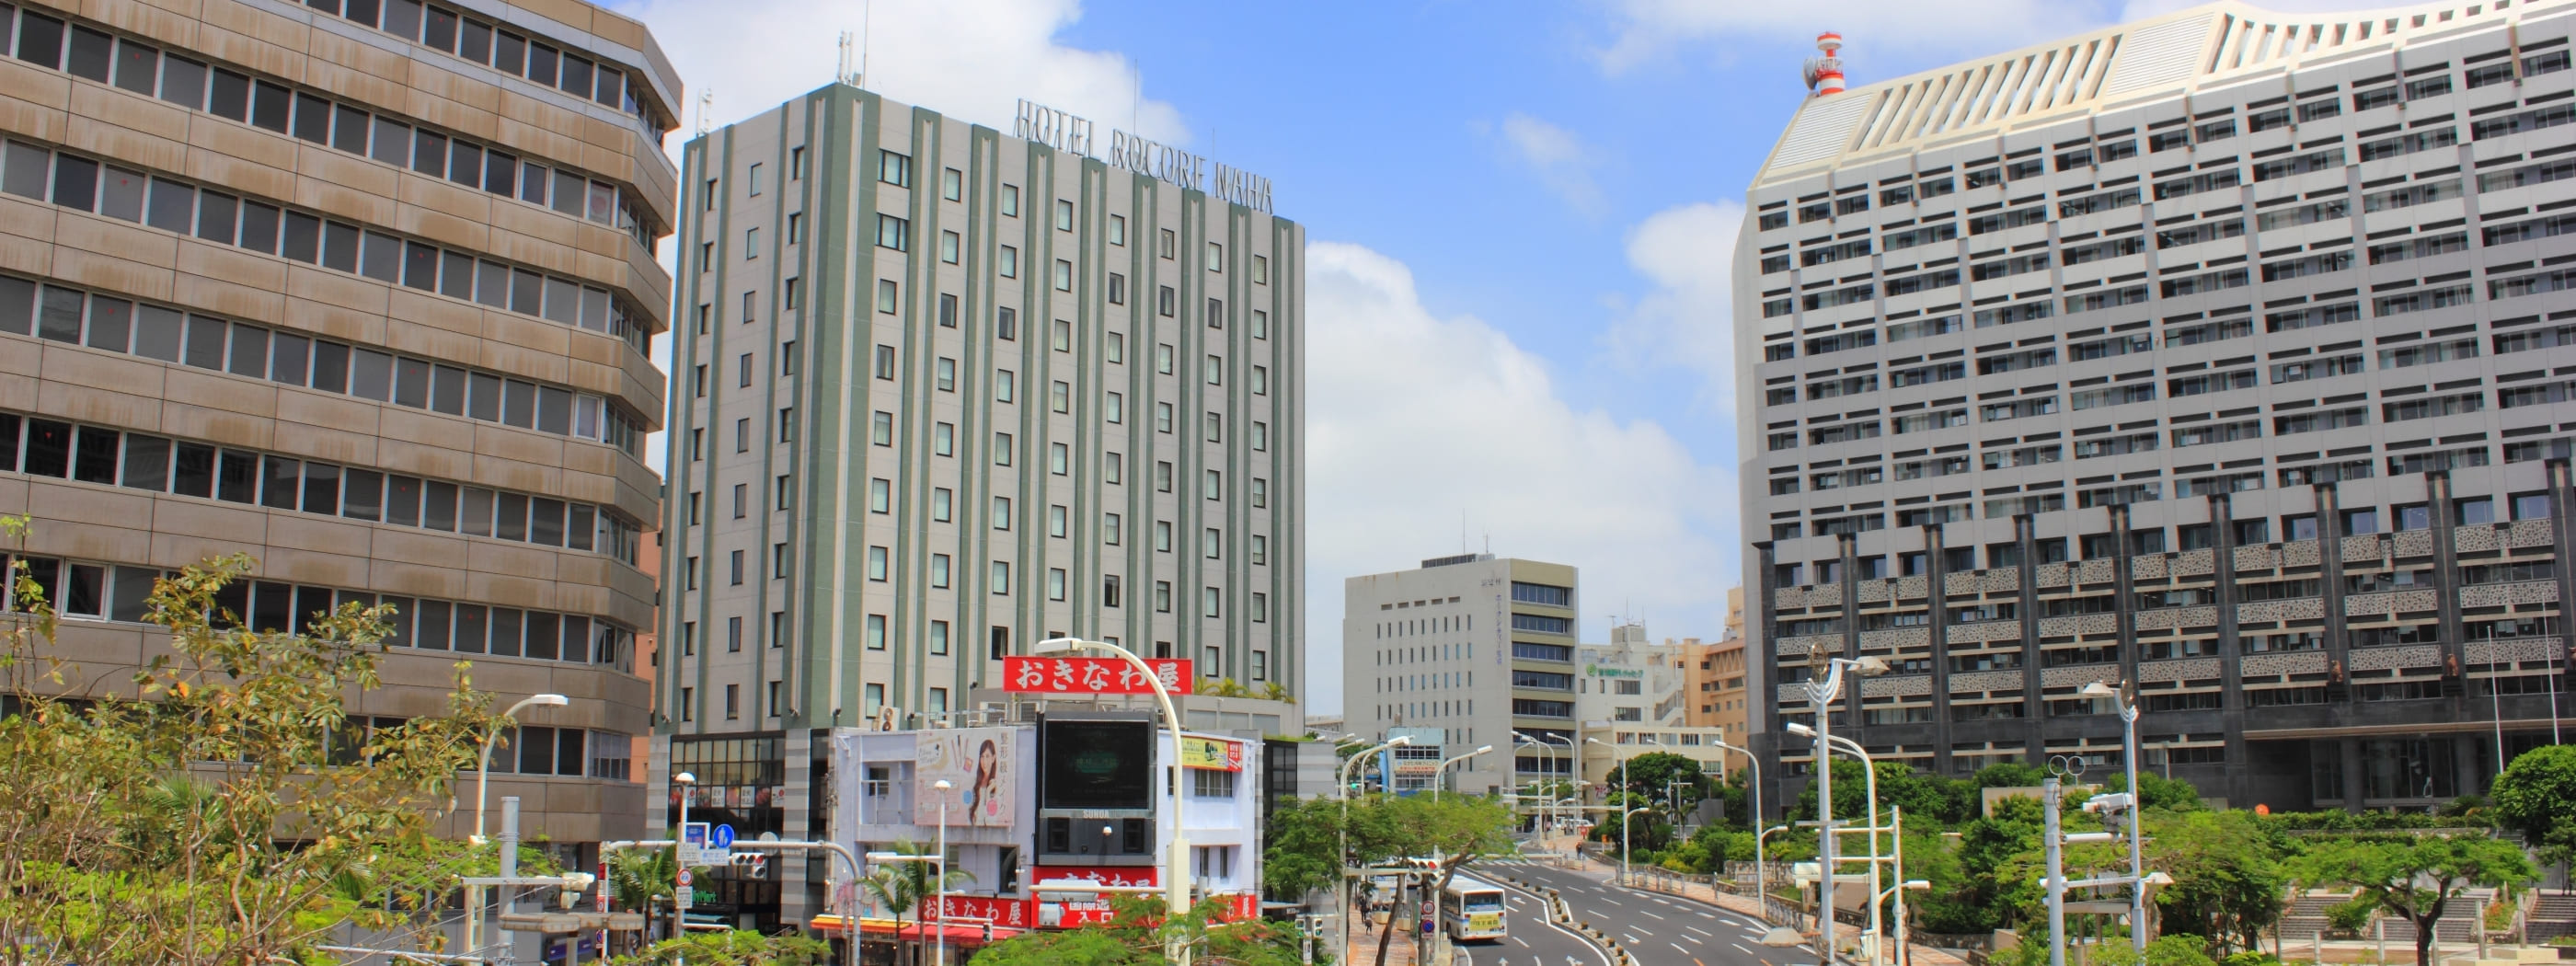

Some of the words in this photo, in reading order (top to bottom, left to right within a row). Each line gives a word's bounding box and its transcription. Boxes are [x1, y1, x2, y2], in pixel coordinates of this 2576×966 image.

[1018, 98, 1100, 161] HOTEL
[1112, 129, 1207, 190] ROCORE
[1216, 162, 1272, 213] NAHA
[1016, 660, 1181, 692] おきなわ屋
[924, 899, 1022, 926] おきなわ屋
